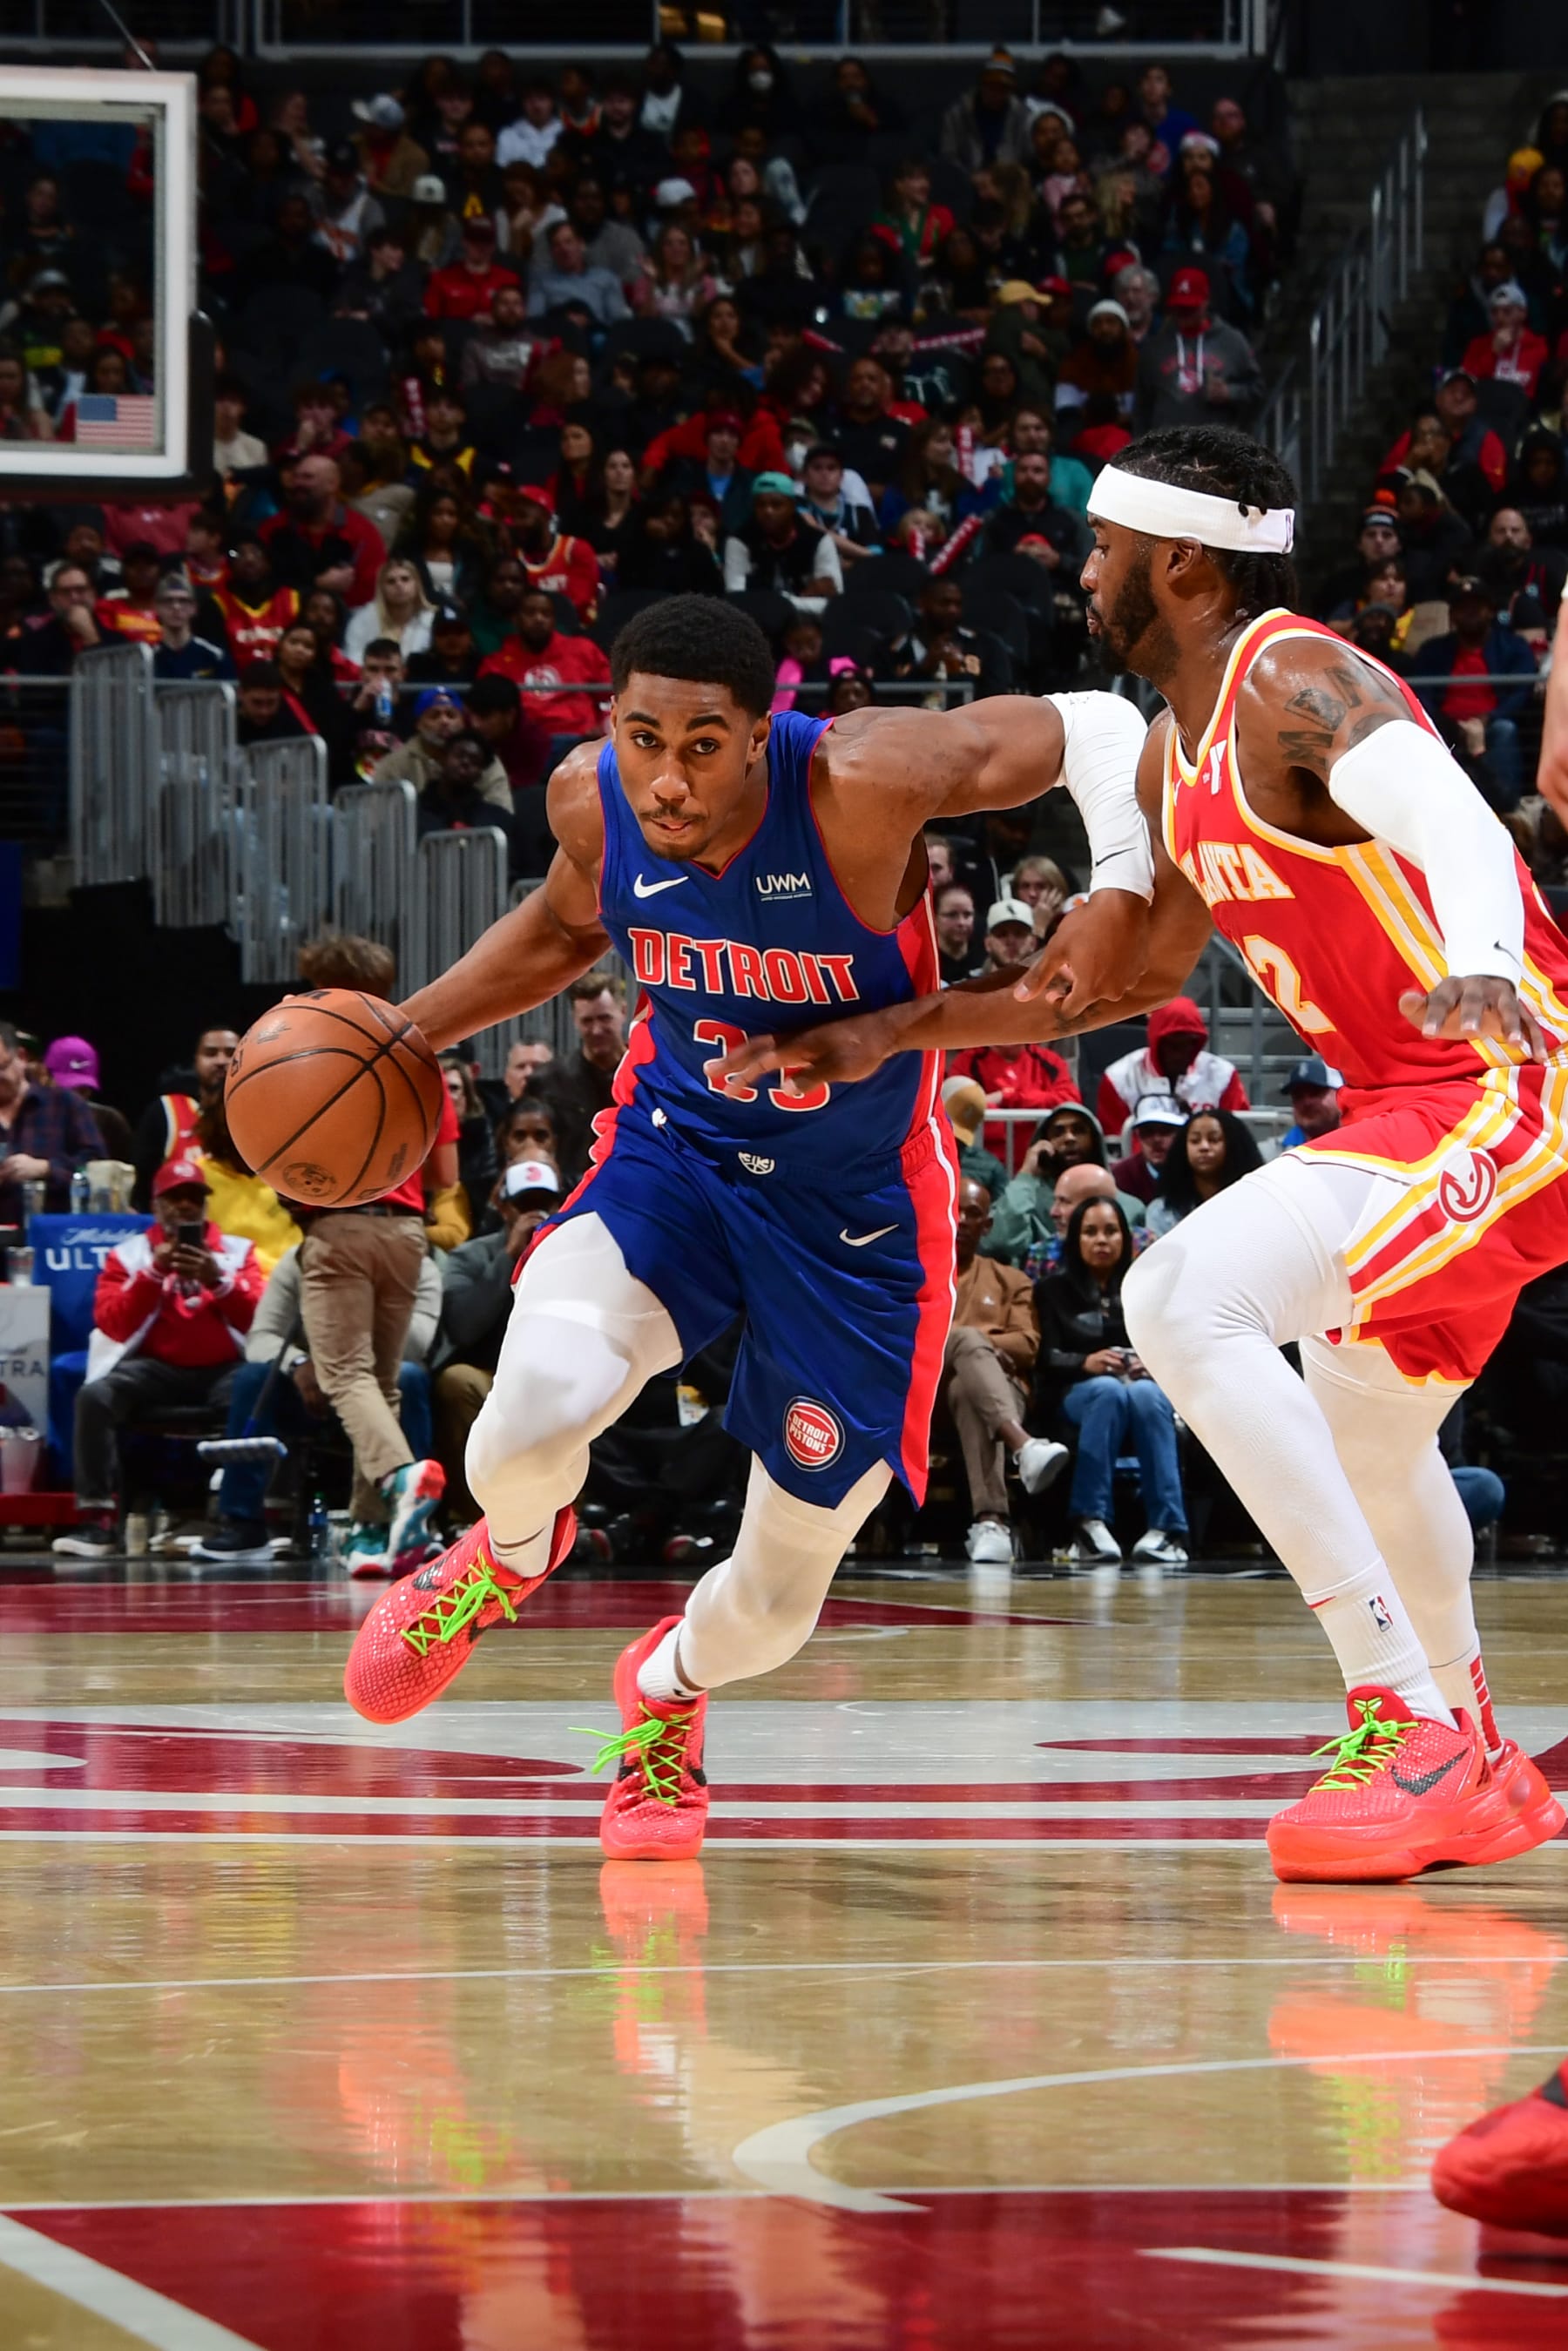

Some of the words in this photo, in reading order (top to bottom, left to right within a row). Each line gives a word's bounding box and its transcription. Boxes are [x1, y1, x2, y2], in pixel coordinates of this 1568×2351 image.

[755, 871, 812, 895] UWM
[627, 927, 861, 1005] DETROIT
[1233, 934, 1338, 1034] 2
[45, 1247, 112, 1271] ULT
[0, 1360, 45, 1378] TRA
[789, 1422, 828, 1455] PISTONS
[792, 1411, 831, 1442] DETROIT
